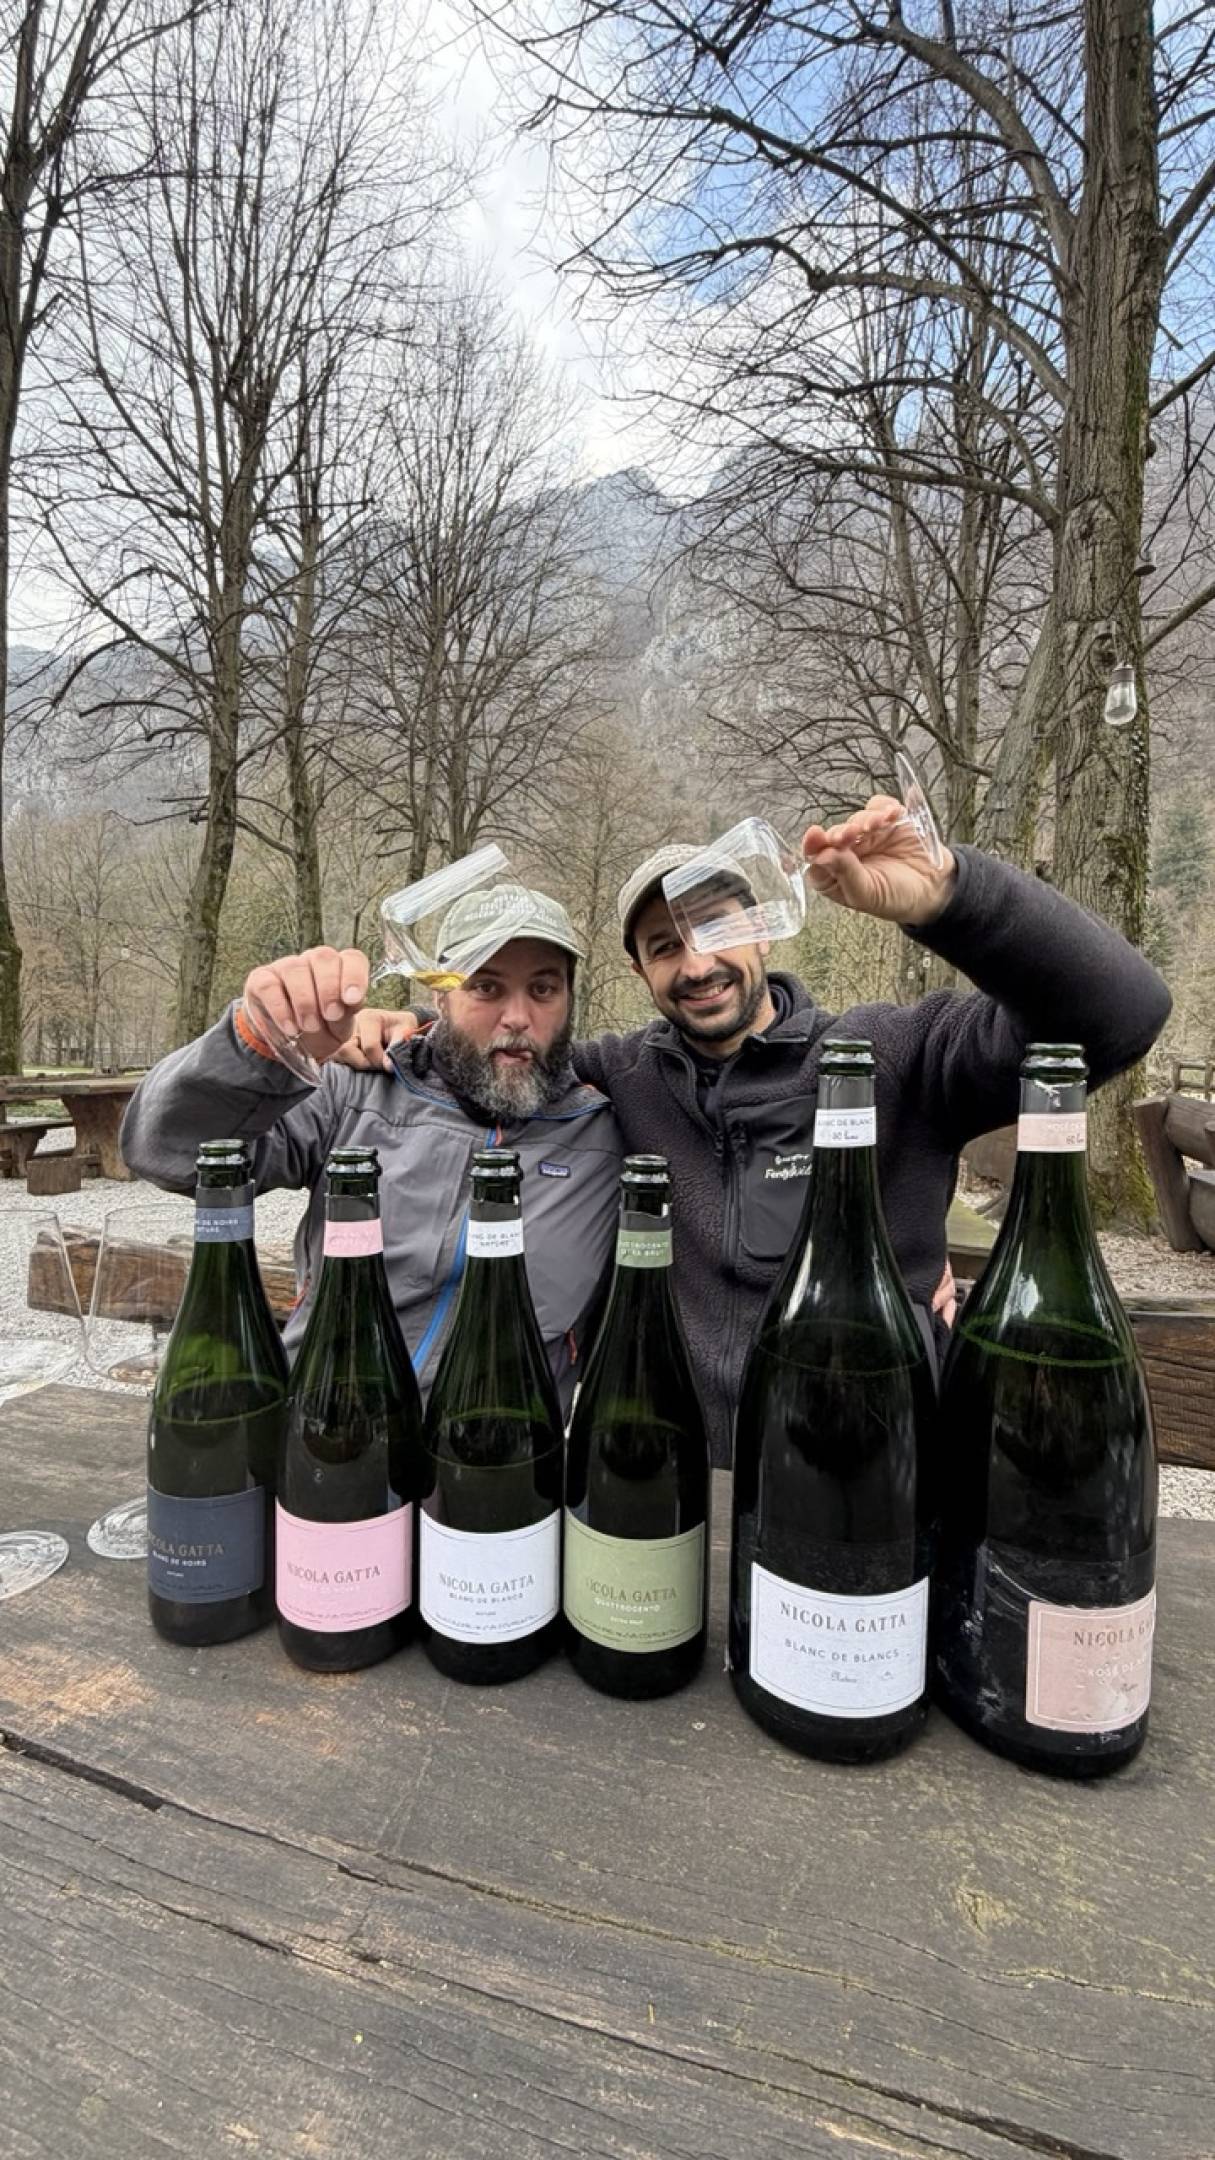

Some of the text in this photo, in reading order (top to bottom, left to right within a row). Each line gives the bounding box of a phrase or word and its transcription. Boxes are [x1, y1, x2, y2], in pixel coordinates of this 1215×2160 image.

[178, 1543, 224, 1557] GATTA
[286, 1561, 382, 1584] NICOLA GATTA
[439, 1572, 534, 1594] NICOLA GATTA
[632, 1587, 677, 1603] GATTA
[780, 1601, 906, 1633] NICOLA GATTA
[1073, 1627, 1135, 1647] NICOLA
[784, 1638, 899, 1663] BLANC DE BLANCS
